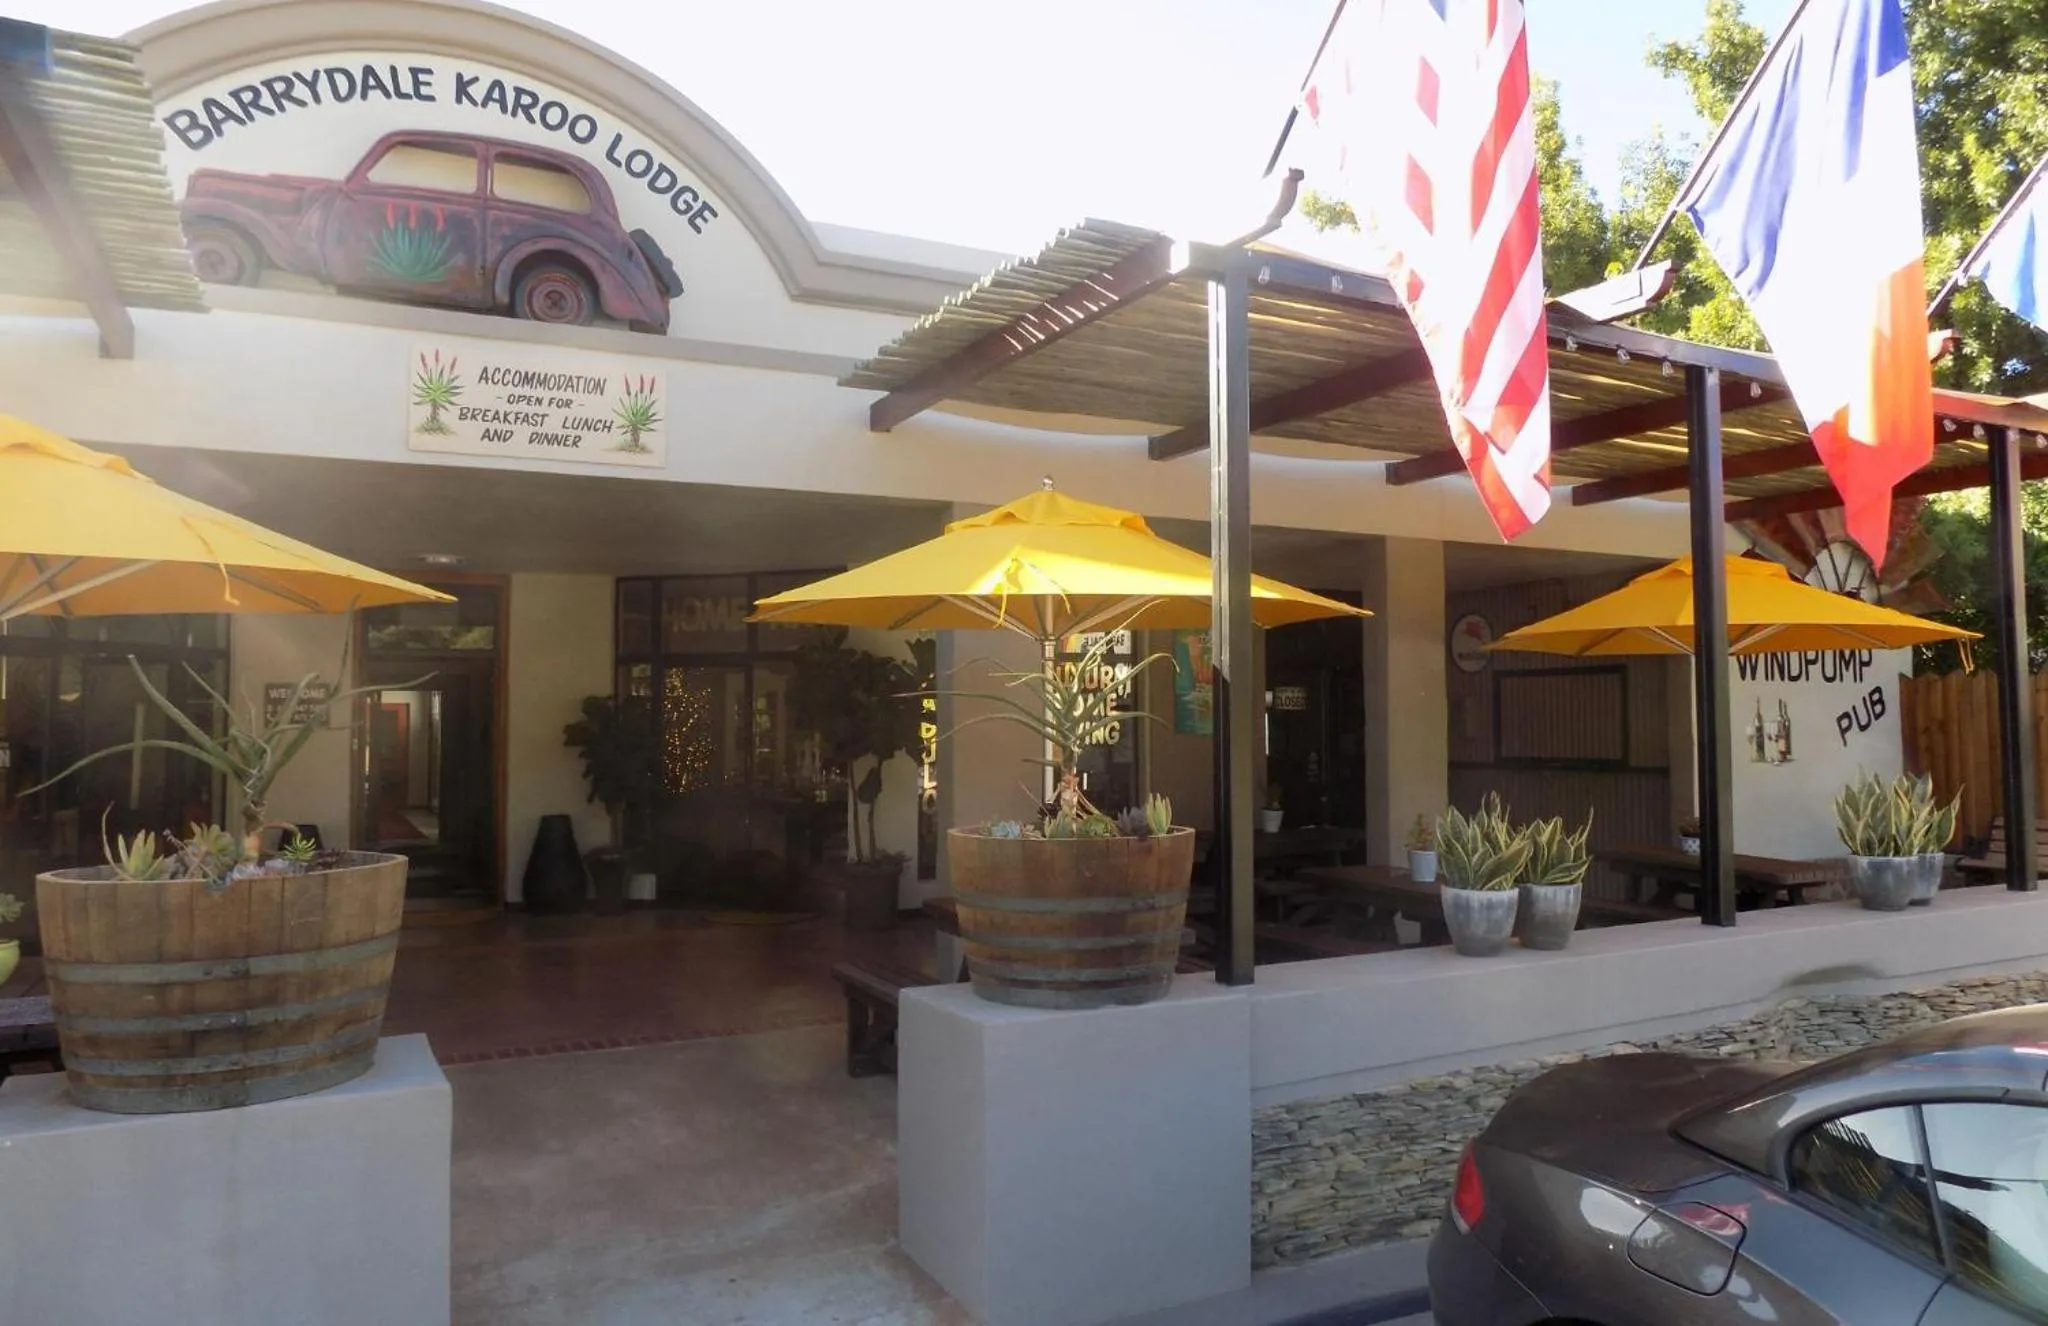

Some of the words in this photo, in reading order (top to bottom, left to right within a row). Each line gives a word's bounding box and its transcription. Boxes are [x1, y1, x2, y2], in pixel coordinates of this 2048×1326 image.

[162, 63, 437, 152] BARRYDALE
[454, 72, 598, 145] KAROO
[605, 132, 719, 234] LODGE
[478, 366, 607, 396] ACCOMMODATION
[507, 394, 543, 407] OPEN
[548, 397, 574, 409] FOR
[458, 407, 549, 427] BREAKFAST
[562, 415, 614, 434] LUNCH
[480, 428, 513, 443] AND
[528, 432, 583, 449] DINNER
[1736, 648, 1873, 683] WINDPUMP
[1836, 685, 1887, 747] PUB
